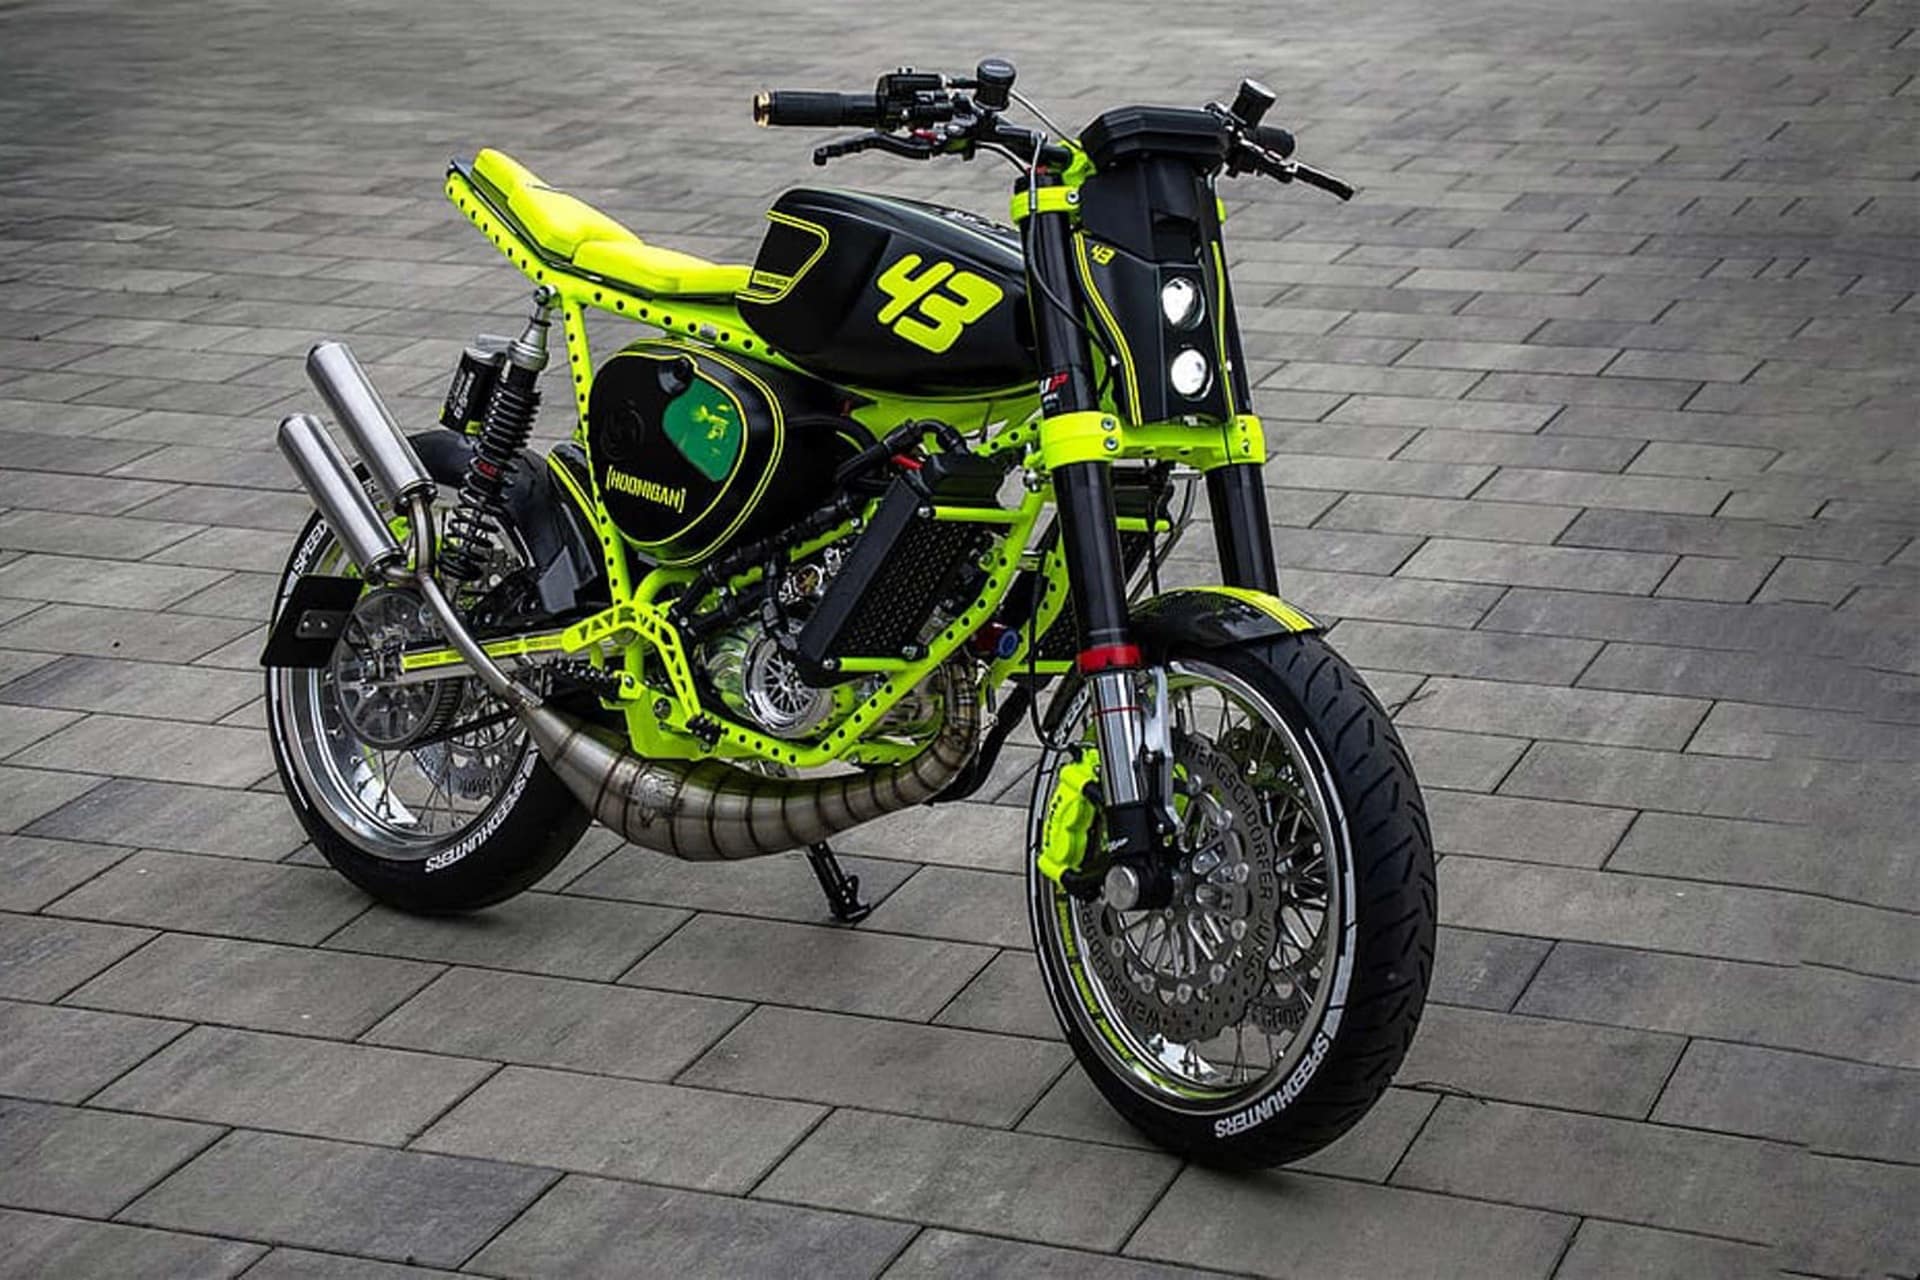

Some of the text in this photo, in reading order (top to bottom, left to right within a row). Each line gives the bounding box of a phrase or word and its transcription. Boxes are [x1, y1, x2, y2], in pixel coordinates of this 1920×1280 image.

[876, 253, 1004, 354] 43
[1092, 244, 1115, 265] 43
[424, 777, 526, 872] SPEEDHUNTERS
[1214, 1032, 1329, 1139] SPEEDHUNTERS
